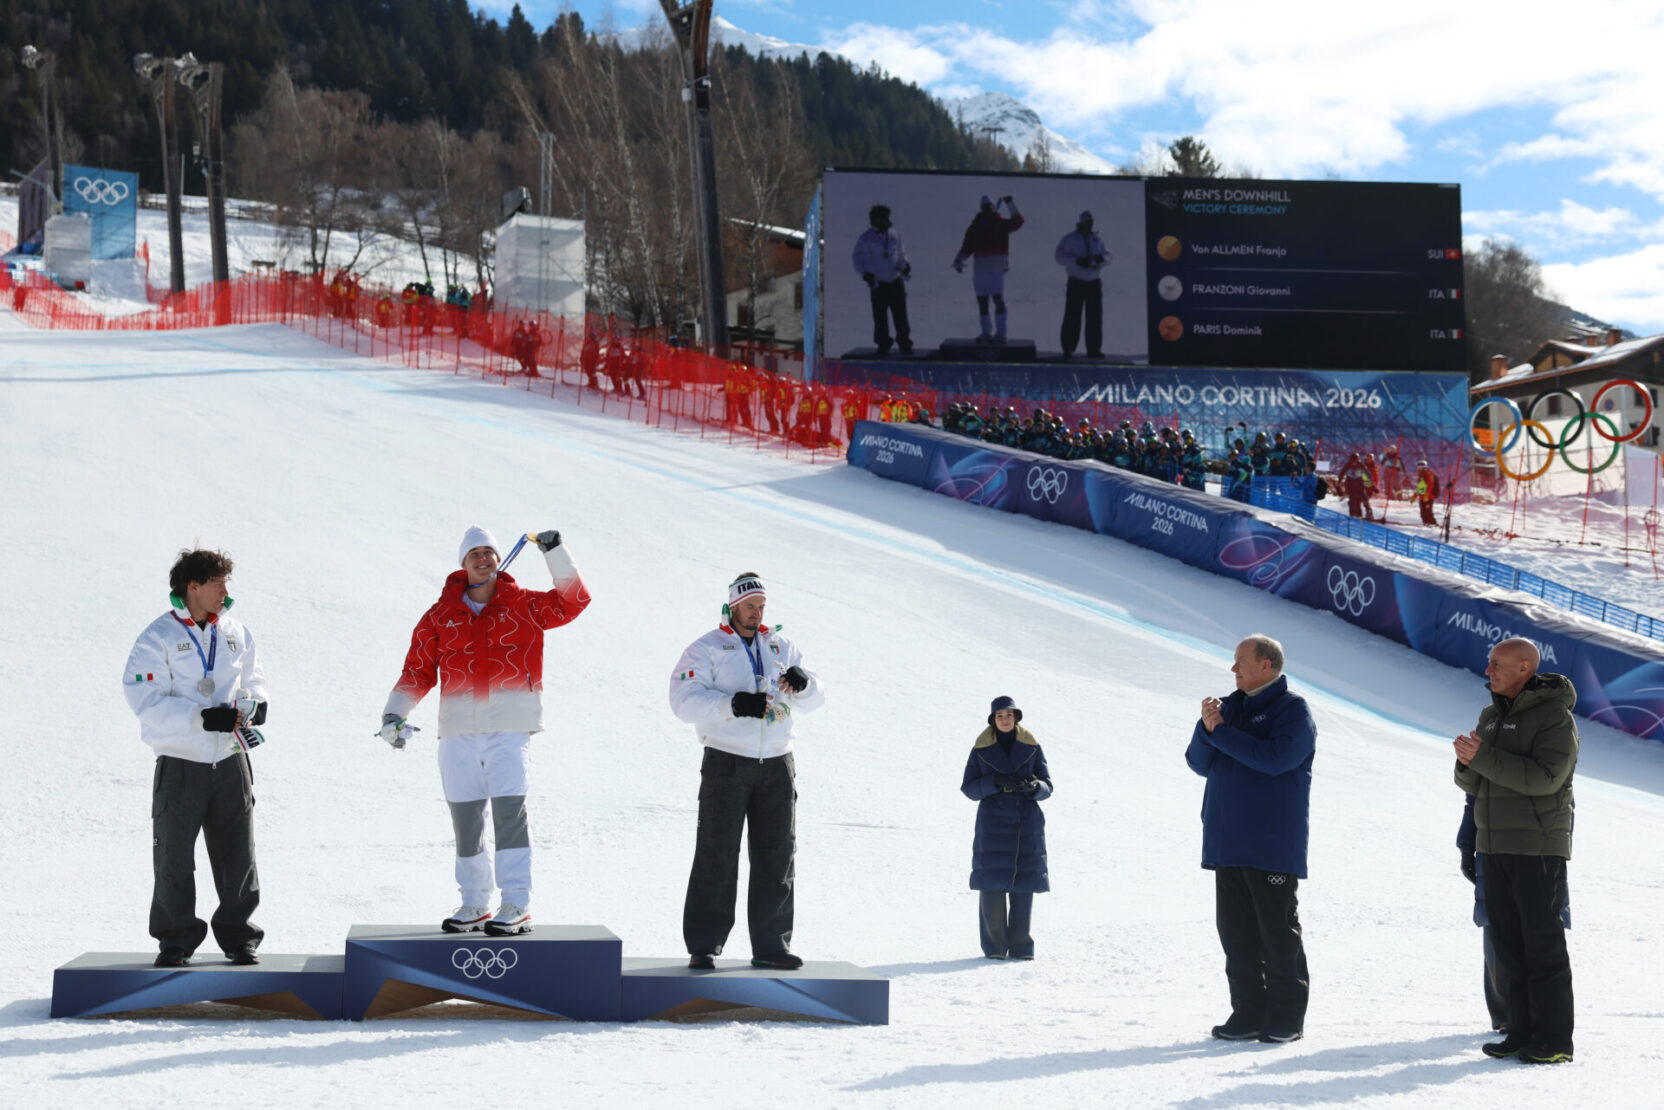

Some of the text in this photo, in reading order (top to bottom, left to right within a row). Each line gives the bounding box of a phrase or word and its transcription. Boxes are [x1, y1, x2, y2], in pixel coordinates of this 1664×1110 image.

[1183, 188, 1291, 202] MEN'S DOWNHILL
[1183, 203, 1288, 215] VICTORY CEREMONY
[1192, 244, 1210, 254] Von
[1212, 245, 1254, 255] ALLMEN
[1428, 249, 1444, 259] SUI
[1192, 284, 1291, 296] FRANZONI Giovanni
[1429, 288, 1445, 299] ITA
[1193, 324, 1262, 335] PARIS Dominik
[1430, 329, 1446, 339] ITA
[1076, 383, 1382, 409] MILANO CORTINA 2026
[888, 438, 924, 458] CORTINA
[876, 449, 895, 465] 2026
[1123, 492, 1209, 533] MILANO CORTINA
[1151, 516, 1174, 536] 2026
[1447, 611, 1501, 641] MILANO
